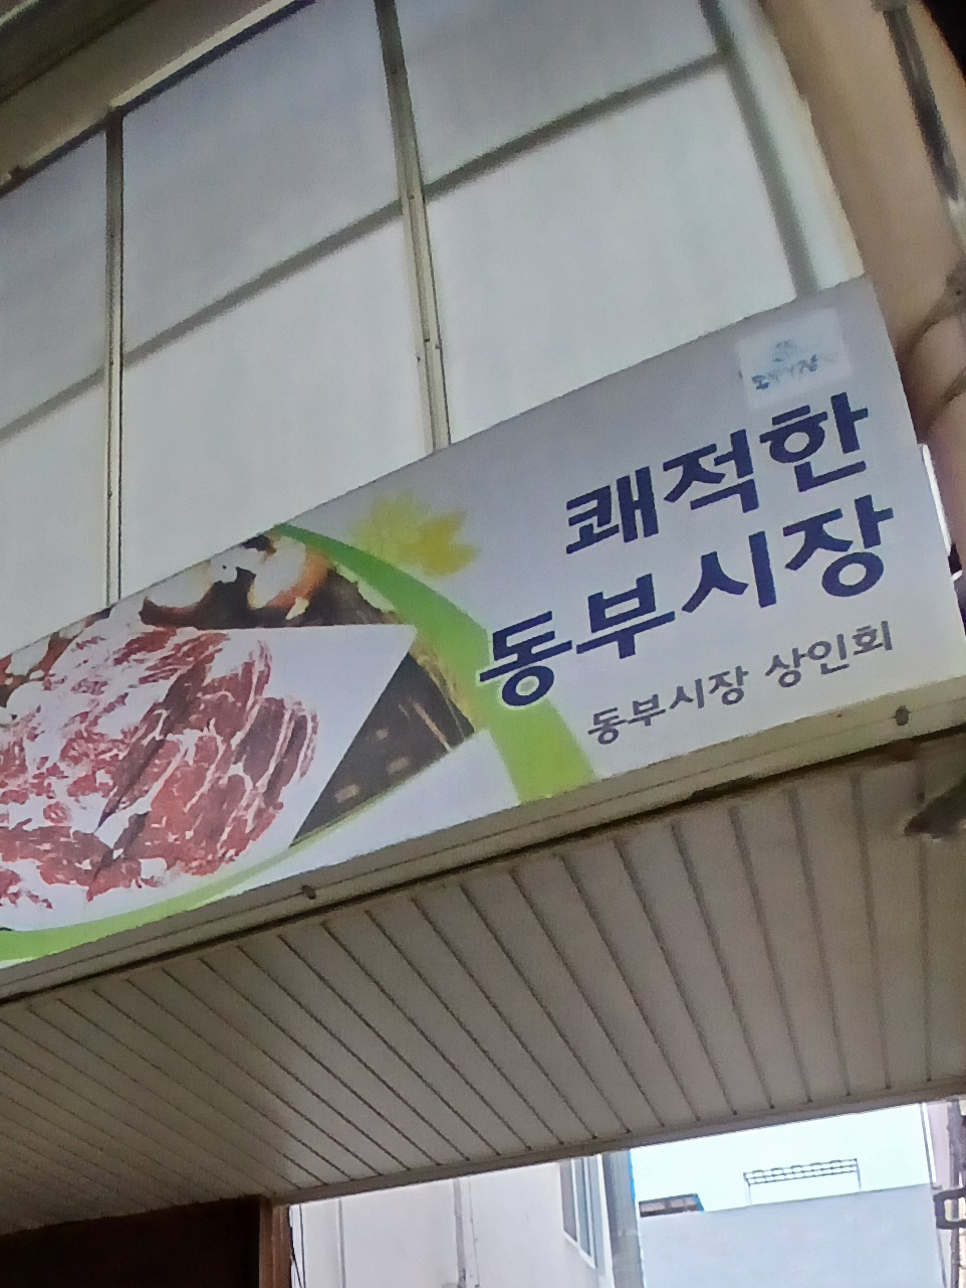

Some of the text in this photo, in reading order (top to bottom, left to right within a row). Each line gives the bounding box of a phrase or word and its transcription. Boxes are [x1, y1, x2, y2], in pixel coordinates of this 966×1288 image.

[565, 391, 869, 555] 쾌적한
[479, 494, 895, 707] 동부시장
[587, 620, 894, 745] 동부시장 상인회
